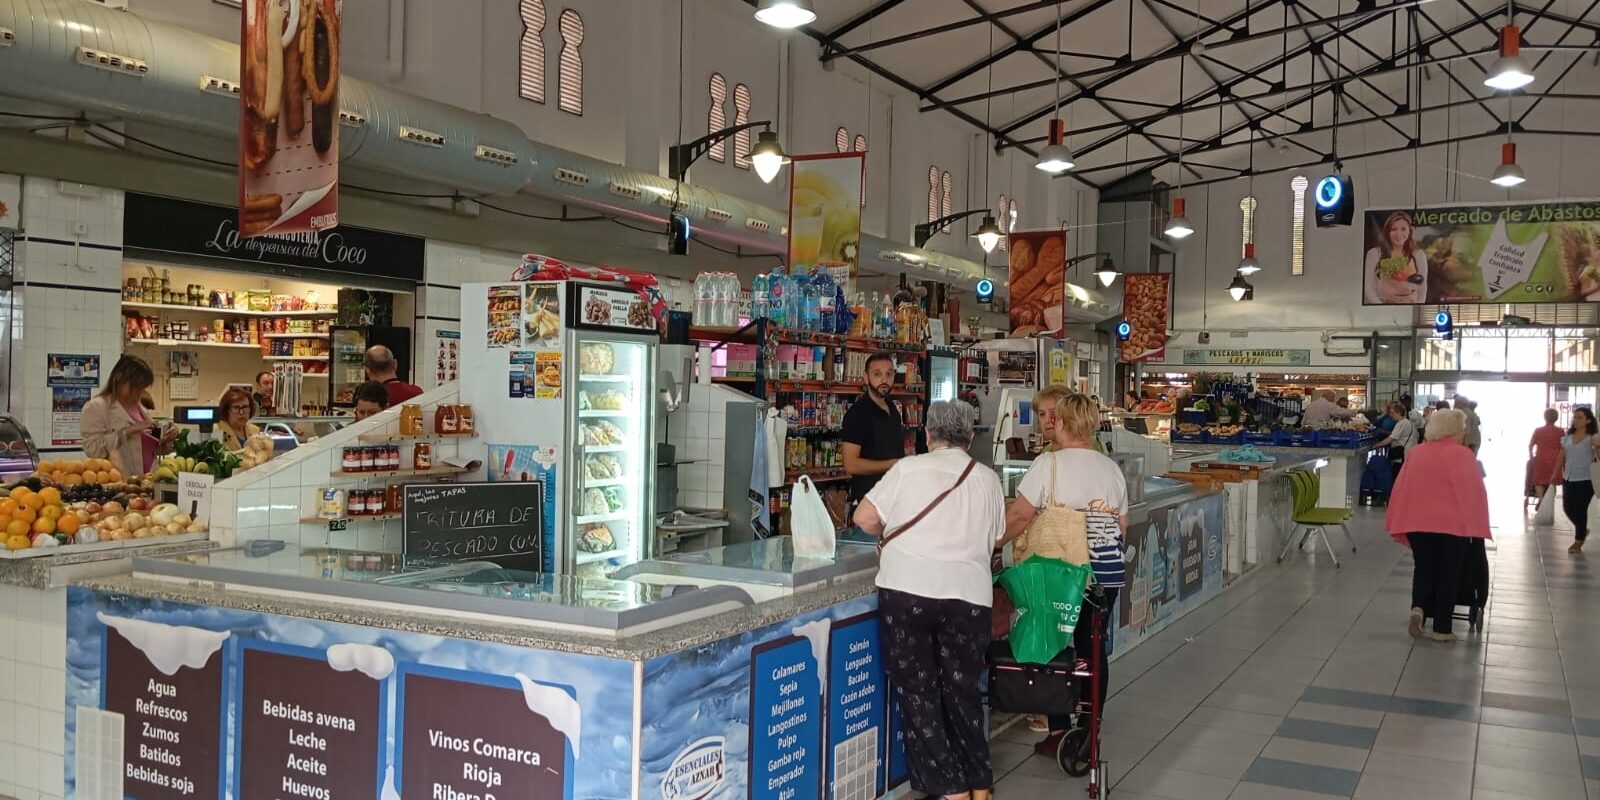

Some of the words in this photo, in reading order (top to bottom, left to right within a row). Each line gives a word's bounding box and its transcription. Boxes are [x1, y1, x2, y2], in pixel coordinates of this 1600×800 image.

[1414, 207, 1492, 225] Mercado
[1500, 208, 1522, 221] de
[1528, 204, 1600, 221] Abastos
[205, 219, 242, 252] La
[301, 239, 321, 257] del
[322, 232, 367, 264] Coco
[1500, 244, 1525, 257] Calidad
[185, 480, 207, 489] CEBOLLA
[187, 490, 204, 498] DULCE
[441, 487, 466, 498] TAPAS
[509, 506, 534, 523] DE
[849, 639, 870, 653] Salmón
[772, 661, 806, 680] Calamares
[845, 653, 872, 671] Lenguado
[147, 678, 177, 698] Agua
[779, 680, 798, 697] Sepia
[848, 670, 869, 686] Bacalao
[841, 689, 858, 705] Cazón
[858, 683, 876, 698] adobo
[136, 698, 188, 722] Refrescos
[263, 699, 314, 724] Bebidas
[316, 712, 356, 732] avena
[771, 696, 805, 717] Mejillones
[844, 701, 872, 720] Croquetas
[142, 722, 180, 744] Zumos
[768, 712, 807, 737] Langostinos
[289, 728, 327, 751] Leche
[428, 729, 471, 753] Vinos
[473, 738, 541, 766] Comarca
[778, 734, 797, 750] Pulpo
[140, 743, 181, 767] Batidos
[286, 753, 327, 776] Aceite
[675, 751, 720, 778] ESENCIALES
[767, 752, 792, 772] Gamba
[792, 746, 806, 761] roja
[126, 763, 170, 787] Bebidas
[171, 777, 195, 795] soja
[463, 762, 502, 788] Rioja
[690, 765, 715, 786] AZNAR
[768, 765, 805, 790] Emperador
[282, 776, 330, 800] Huevos
[779, 786, 795, 800] Atún
